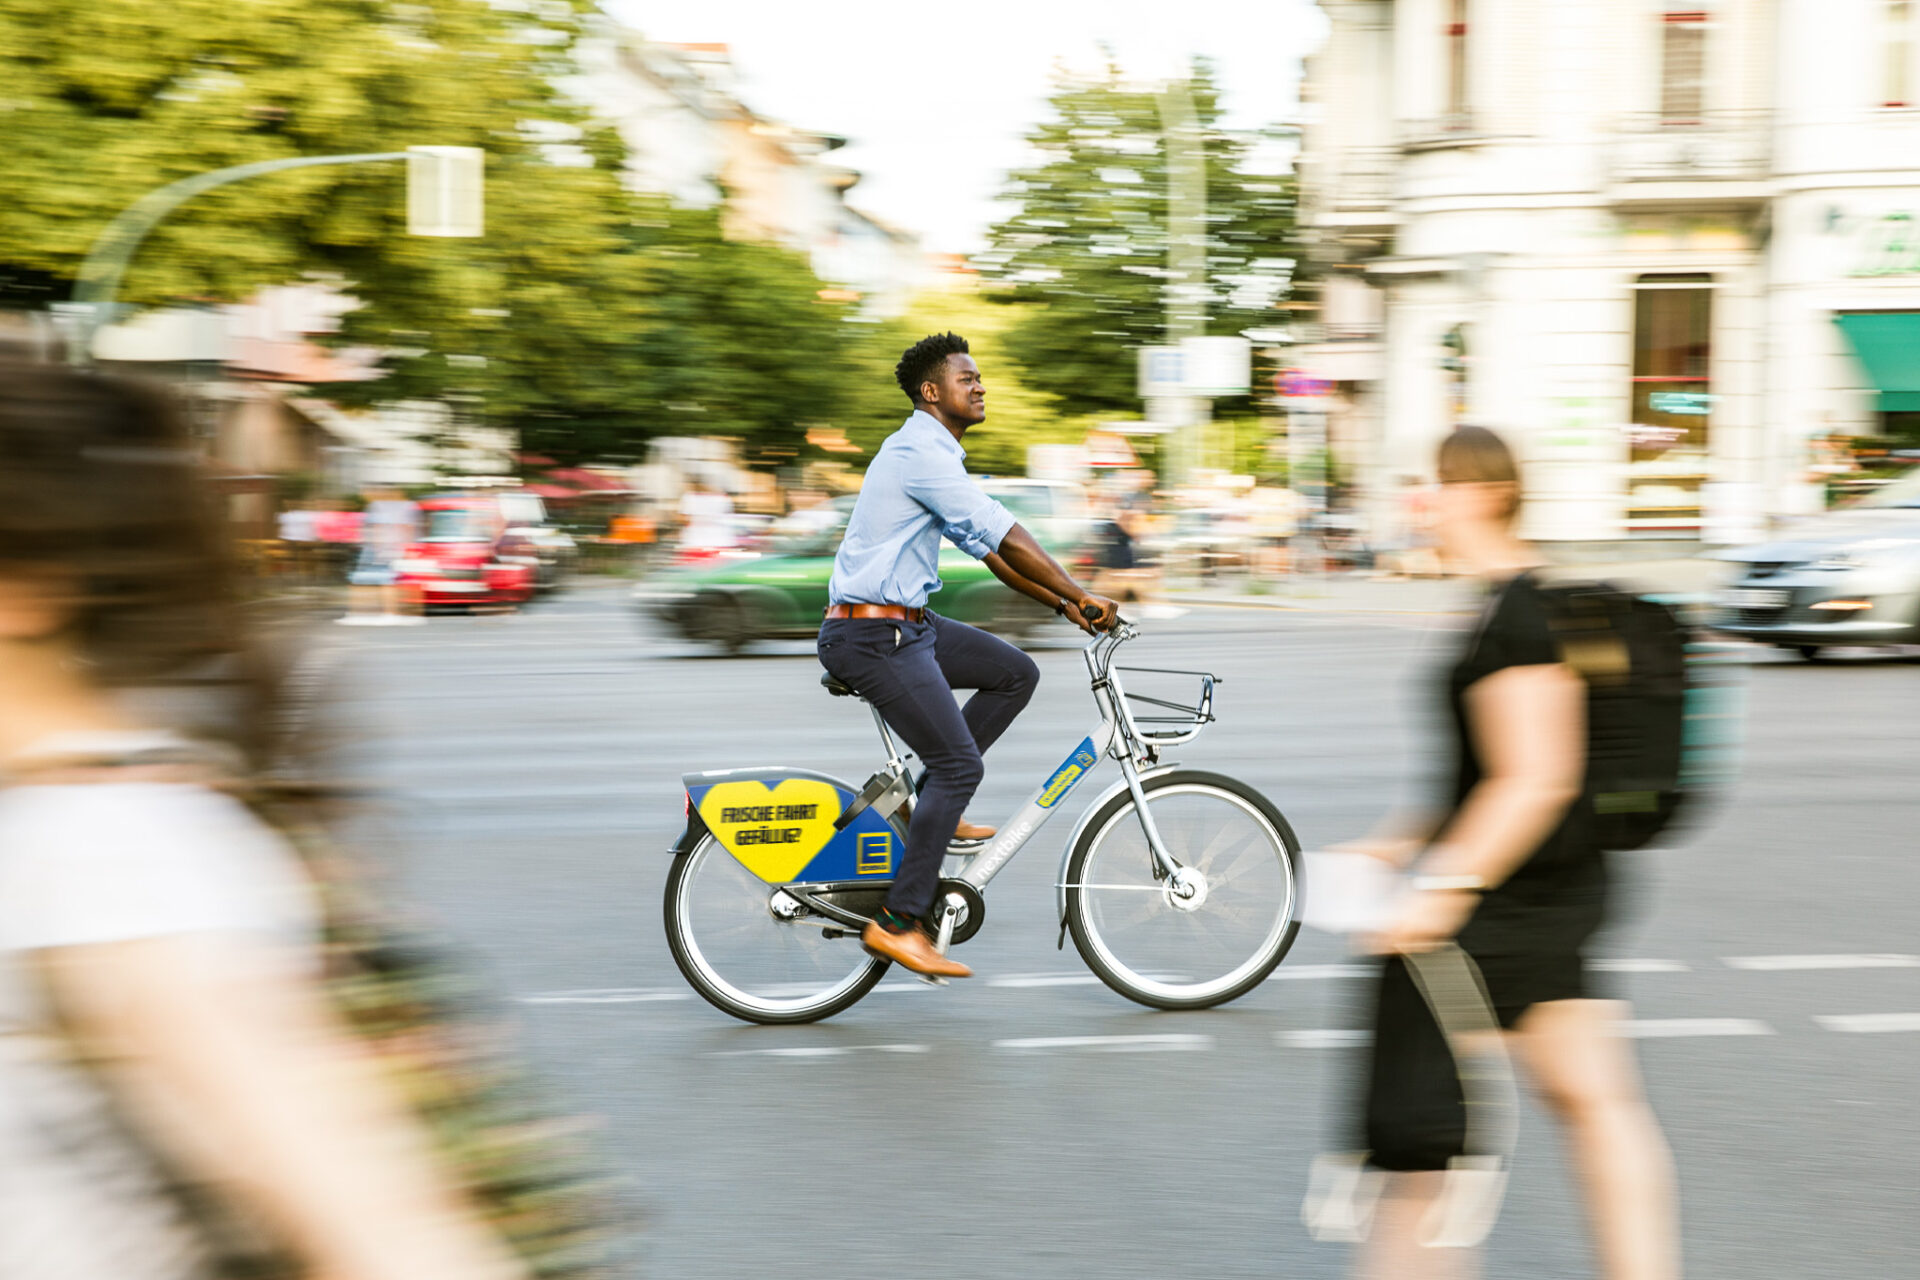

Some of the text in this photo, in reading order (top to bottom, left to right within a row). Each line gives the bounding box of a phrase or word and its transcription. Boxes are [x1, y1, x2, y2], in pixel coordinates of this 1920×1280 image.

[720, 803, 818, 823] FRISCHE FAHRT
[735, 825, 802, 845] GEFÄLLIG?
[976, 822, 1032, 879] nextbike
